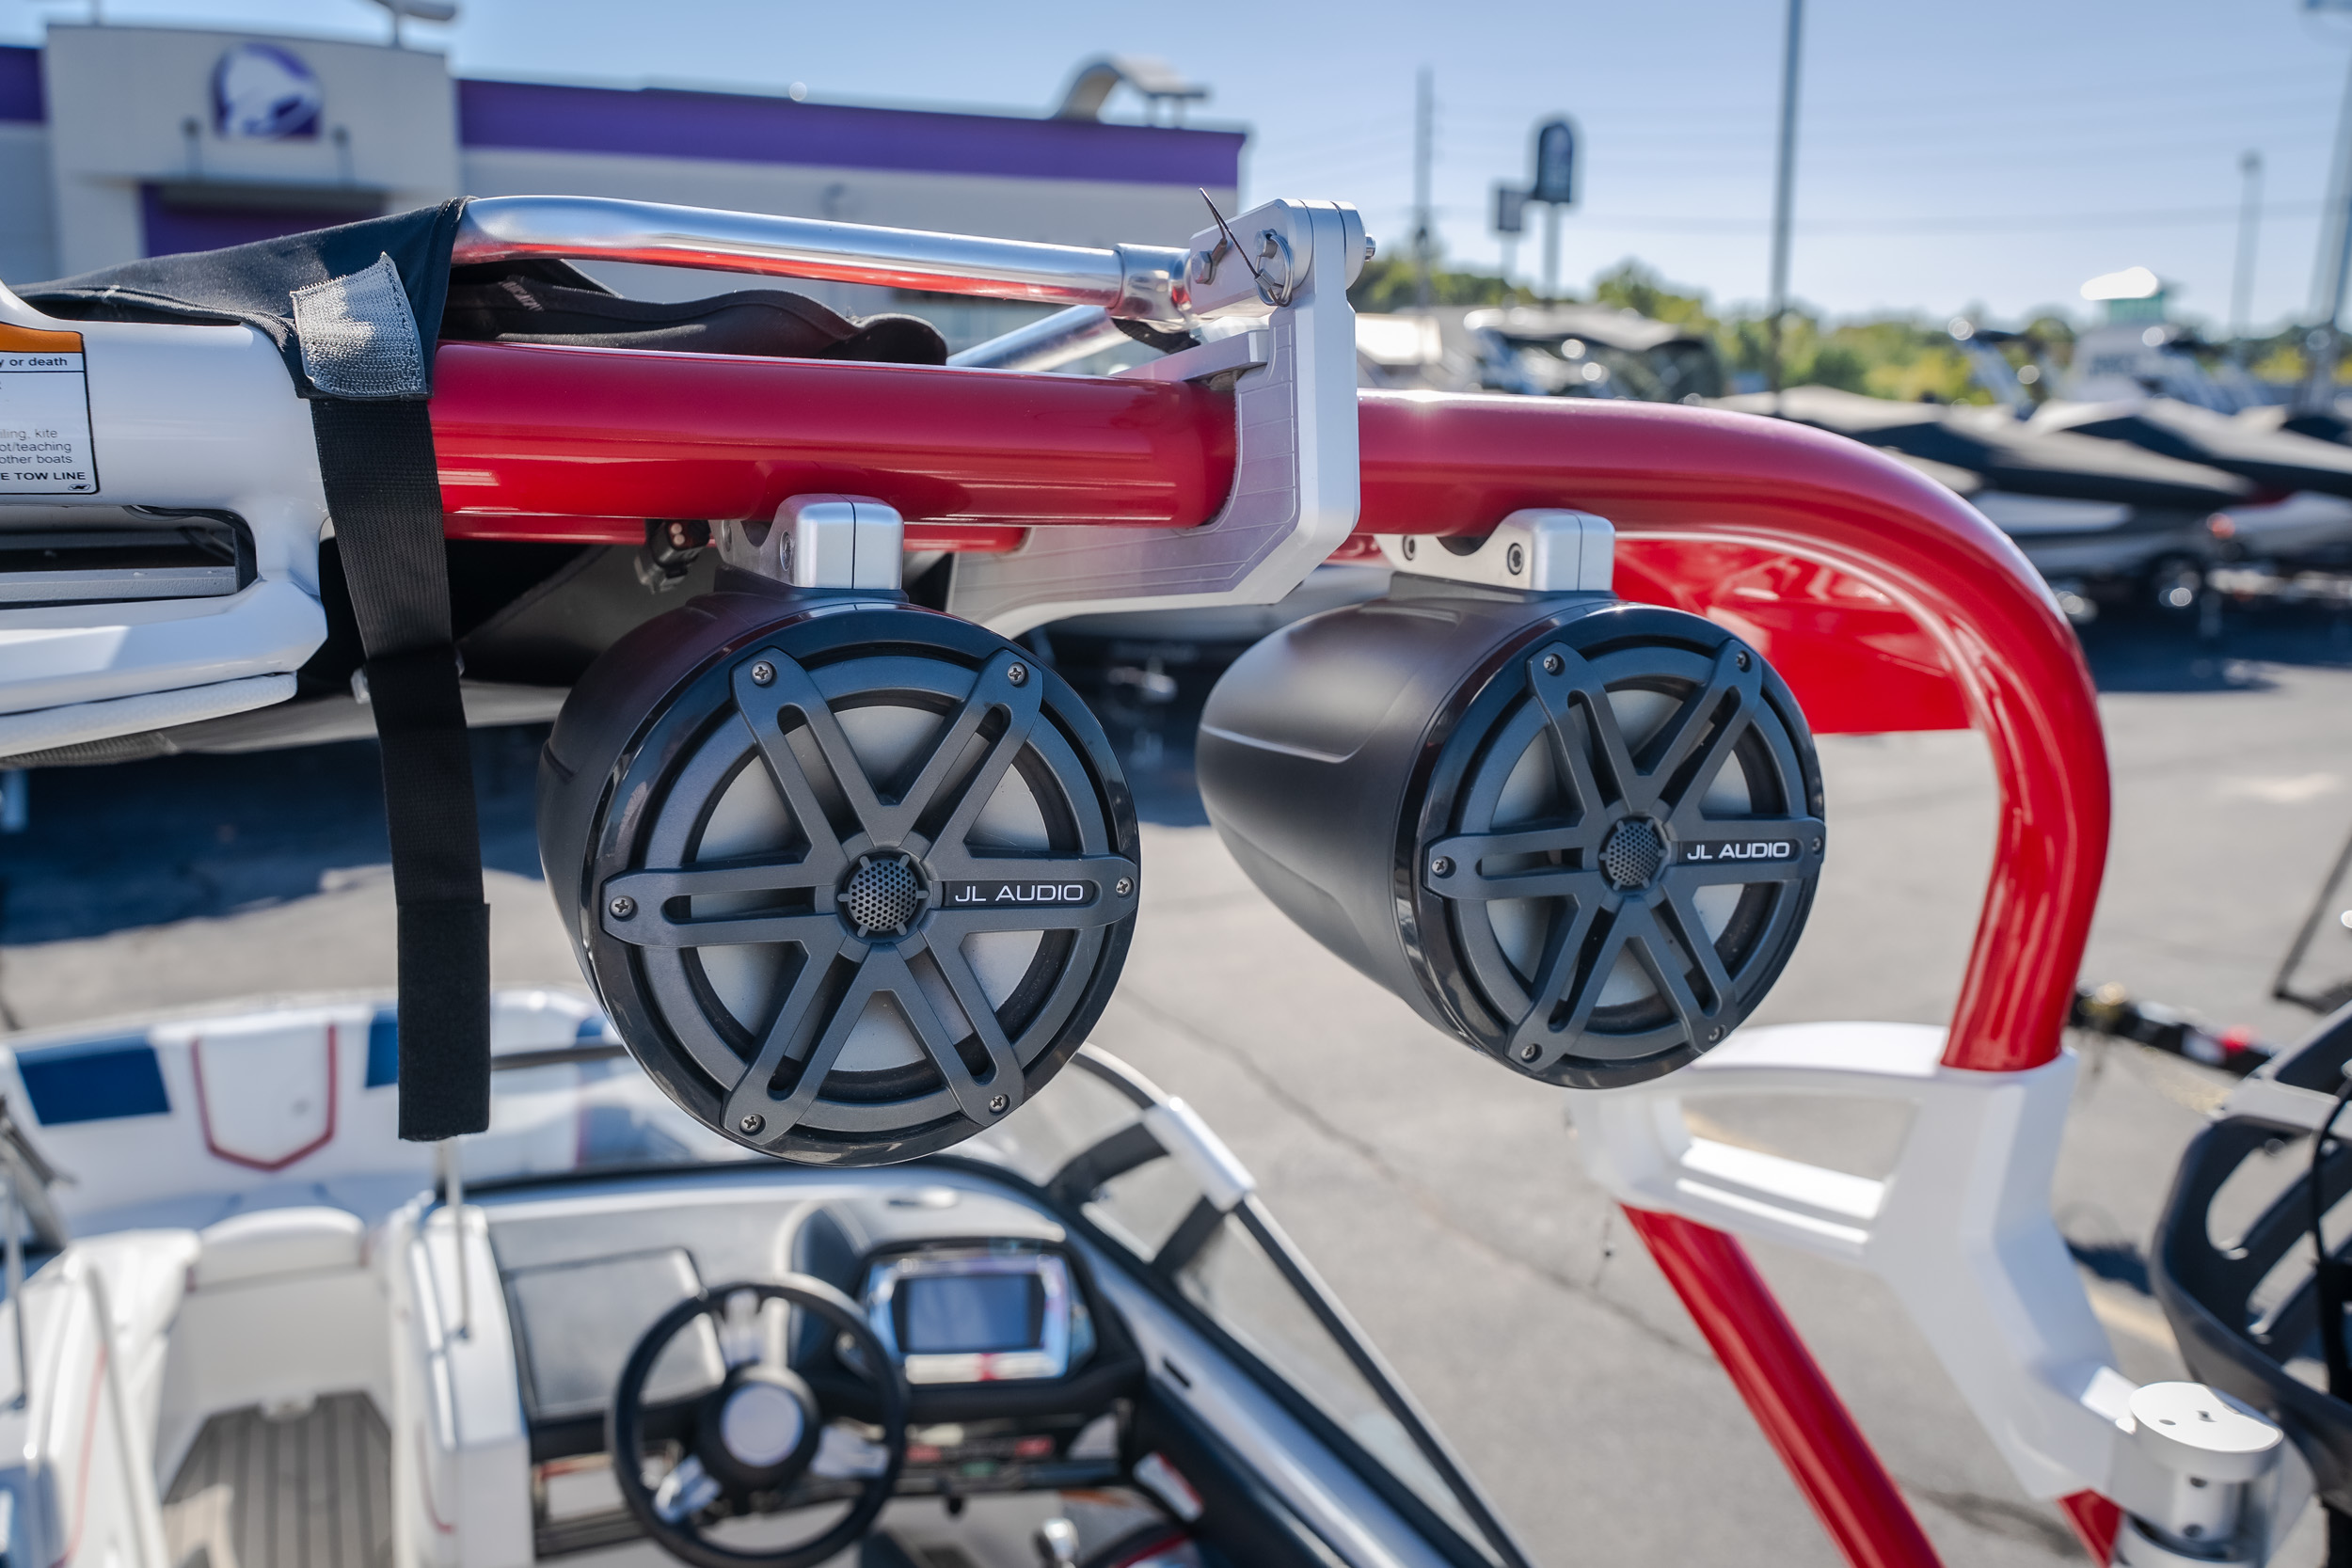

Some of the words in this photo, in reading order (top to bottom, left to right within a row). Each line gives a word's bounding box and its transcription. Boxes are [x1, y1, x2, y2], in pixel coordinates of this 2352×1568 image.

[9, 358, 24, 367] or
[28, 356, 68, 367] death
[35, 428, 58, 439] kite
[0, 454, 32, 465] other
[14, 472, 48, 481] TOW
[54, 471, 87, 481] LINE
[1687, 844, 1712, 860] JL
[1718, 842, 1790, 859] AUDIO
[955, 885, 986, 902] JL
[994, 884, 1084, 902] AUDIO
